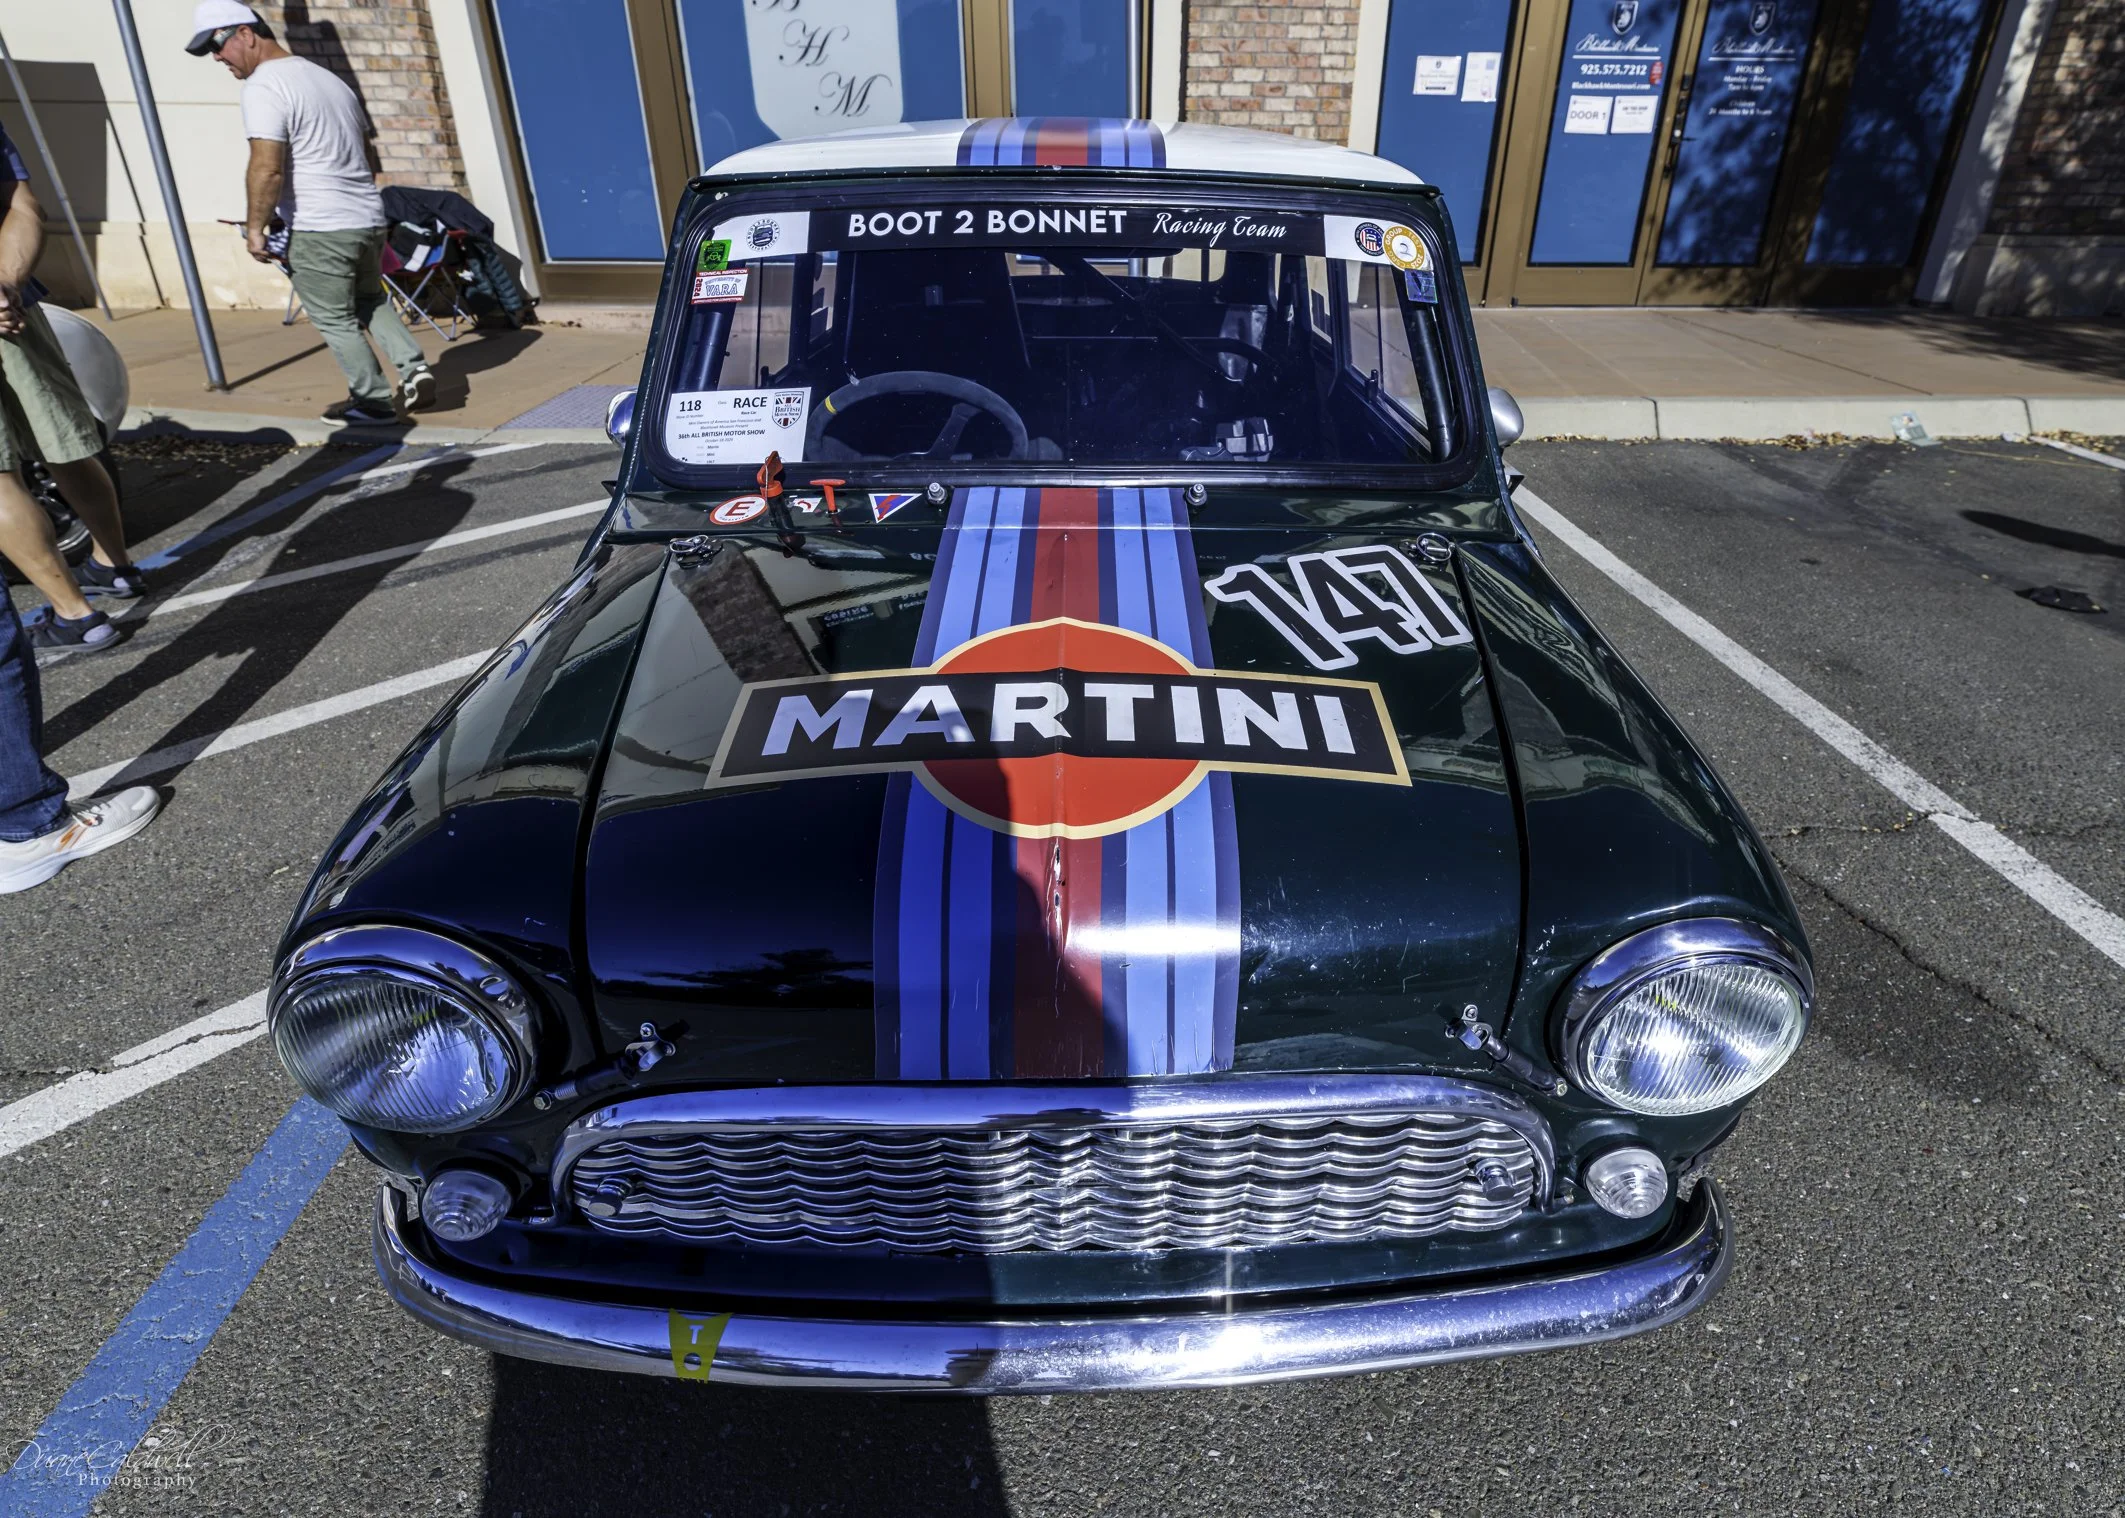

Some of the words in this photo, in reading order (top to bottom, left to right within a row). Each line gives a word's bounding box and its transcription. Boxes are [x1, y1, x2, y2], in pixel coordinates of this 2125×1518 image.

[779, 18, 850, 67] H
[1580, 64, 1648, 76] 925.575.7212
[1735, 65, 1765, 75] HOURS
[814, 71, 893, 117] M
[1570, 110, 1599, 120] DOOR
[848, 211, 942, 237] BOOT
[953, 210, 974, 234] 2
[987, 209, 1127, 234] BONNET
[1152, 212, 1227, 247] Racing
[1232, 216, 1287, 238] Team
[1385, 228, 1403, 245] GROUP
[693, 278, 703, 297] 2024
[705, 283, 738, 297] VARA
[679, 400, 702, 412] 118
[733, 397, 768, 408] RACE
[725, 501, 756, 516] E
[1204, 545, 1474, 670] 147
[761, 682, 1356, 756] MARTINI
